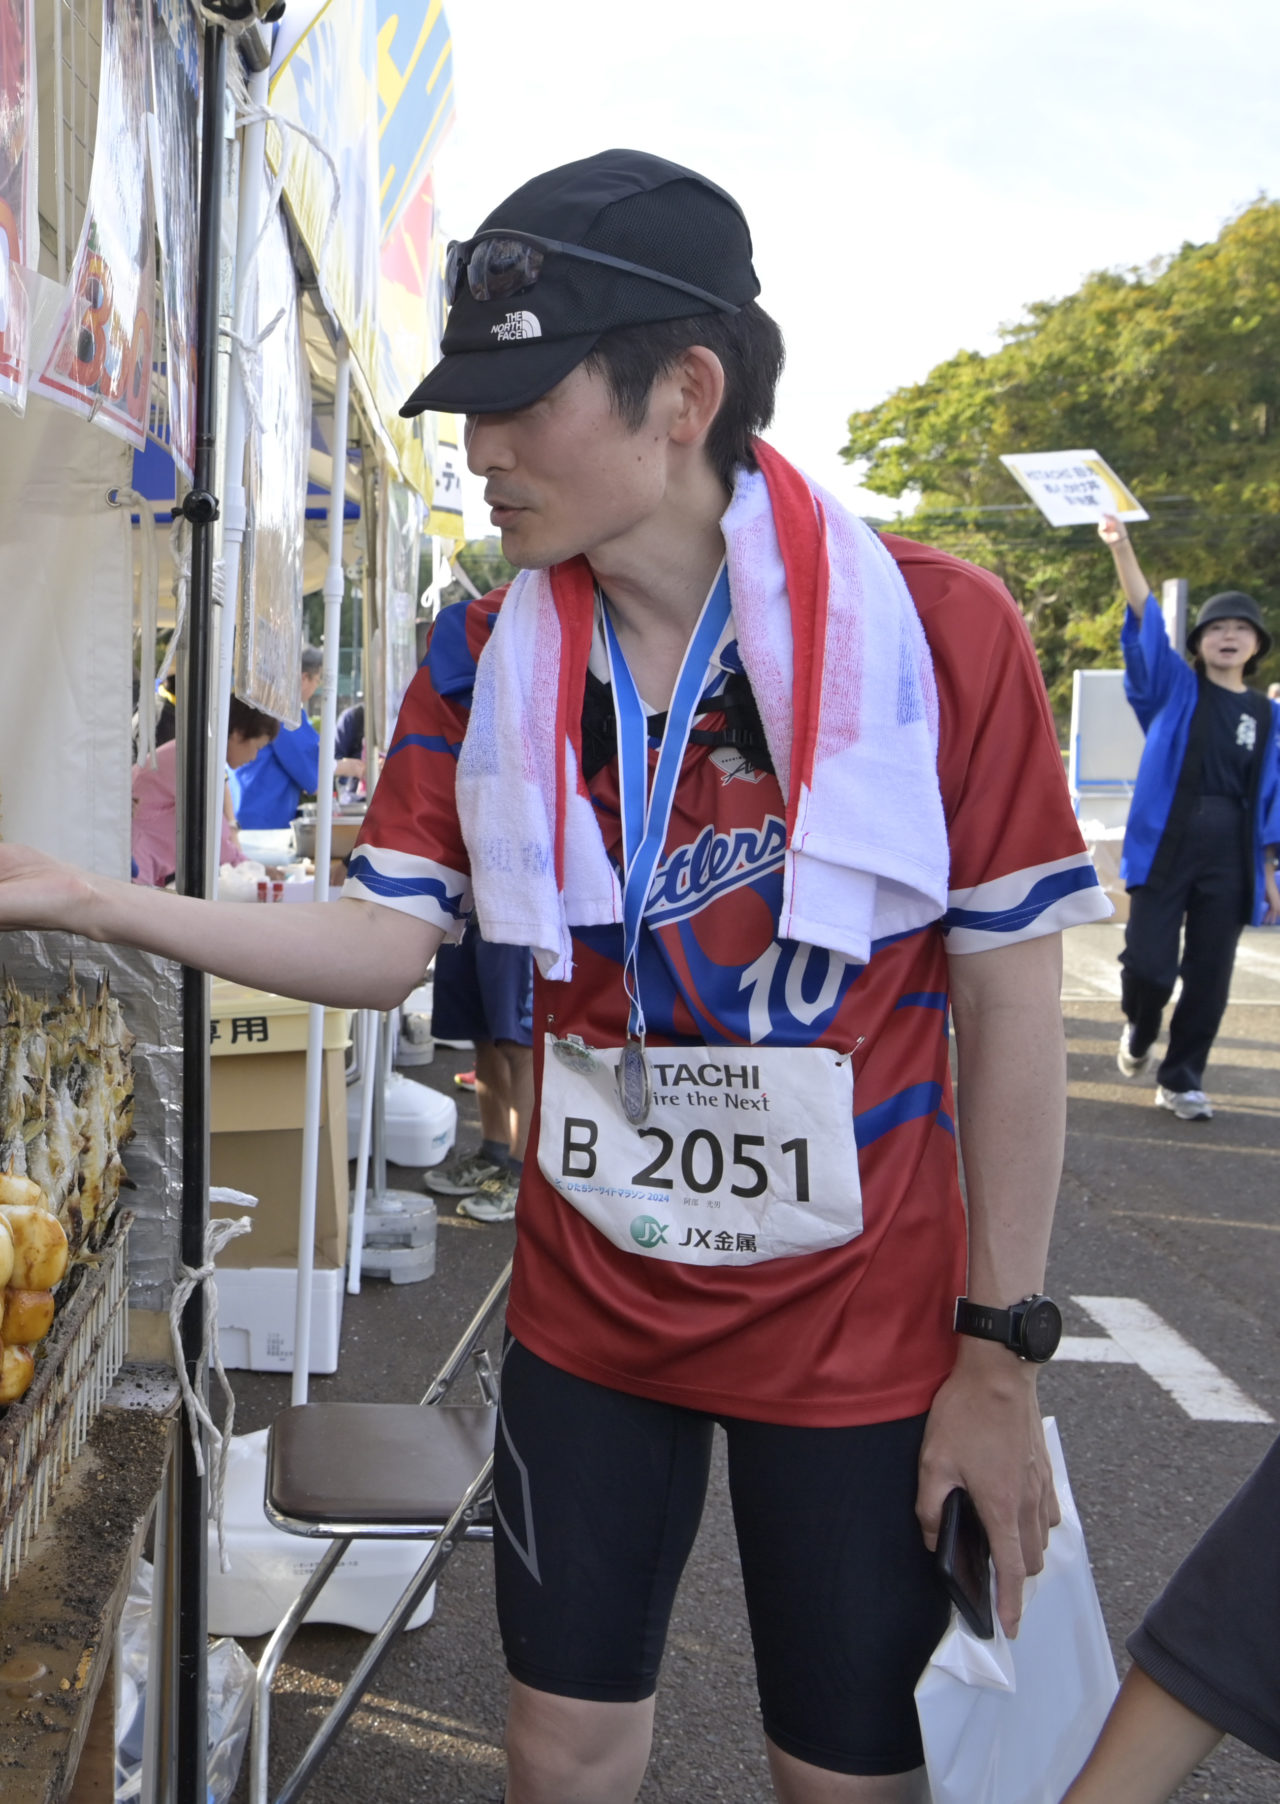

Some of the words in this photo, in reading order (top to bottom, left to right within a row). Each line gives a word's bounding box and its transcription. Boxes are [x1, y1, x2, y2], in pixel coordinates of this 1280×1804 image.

[490, 321, 522, 334] NORTH
[505, 311, 522, 322] THE
[497, 330, 523, 341] FACE
[646, 814, 787, 912] tlers
[738, 941, 847, 1046] 10
[614, 1063, 760, 1090] TACHI
[686, 1091, 719, 1107] the
[724, 1093, 771, 1112] Next
[561, 1117, 599, 1179] B
[631, 1126, 810, 1203] 2051
[647, 1191, 670, 1204] 2024
[637, 1222, 670, 1245] JX
[679, 1227, 758, 1252] JX金属
